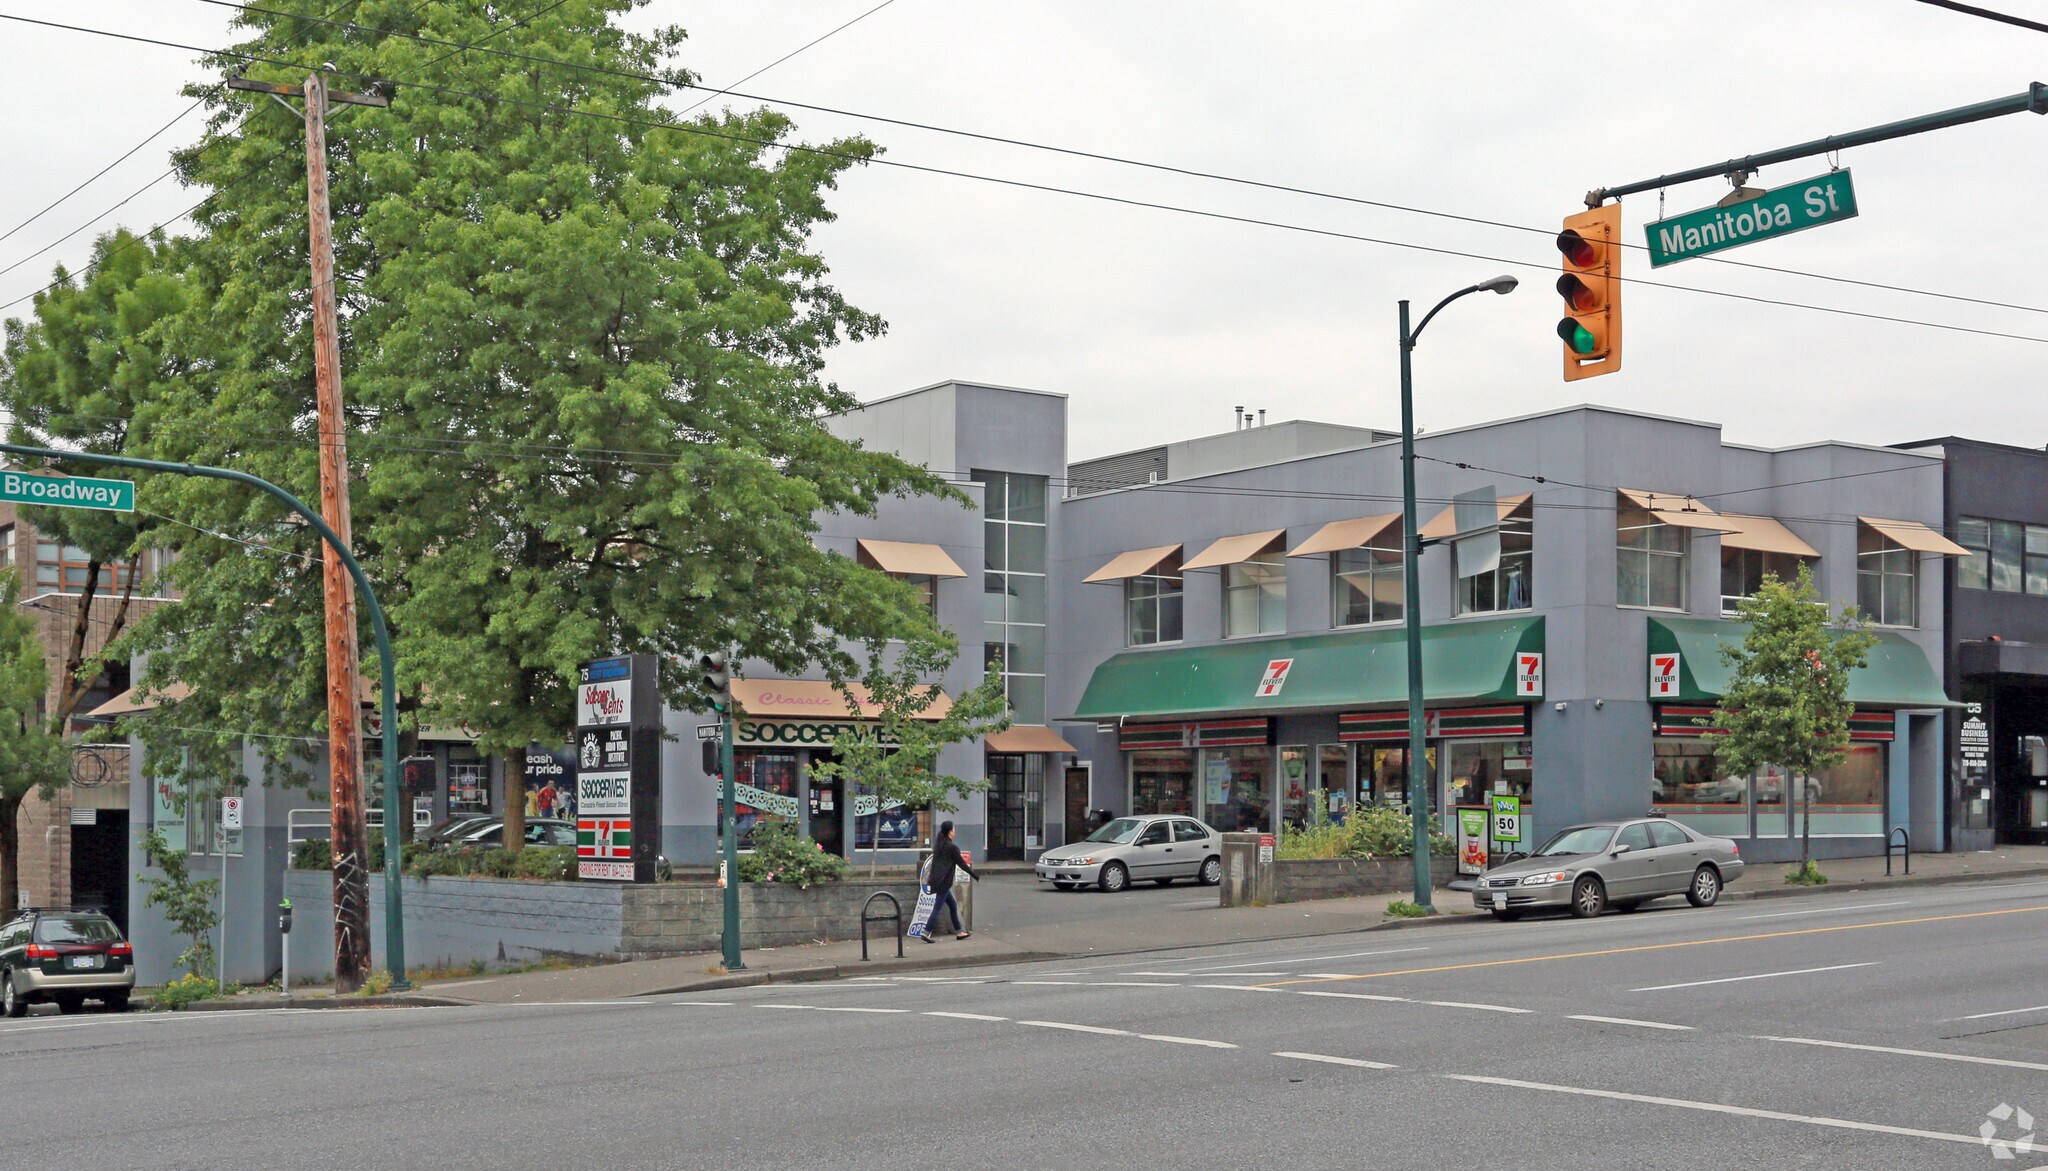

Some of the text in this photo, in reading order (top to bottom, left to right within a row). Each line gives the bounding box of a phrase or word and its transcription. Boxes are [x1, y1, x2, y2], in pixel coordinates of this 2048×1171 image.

[1659, 184, 1840, 257] Manitoba St
[4, 474, 121, 507] Broadway
[581, 668, 589, 681] 75
[1263, 660, 1291, 694] 7
[1521, 656, 1539, 692] 7
[1655, 657, 1675, 692] 7
[758, 691, 832, 706] Classic
[1961, 729, 1988, 737] BUSINESS
[1963, 721, 1986, 730] SUMMIT
[535, 763, 563, 776] pride
[1497, 800, 1515, 812] MAX
[598, 820, 610, 856] 7
[910, 924, 927, 935] OPE
